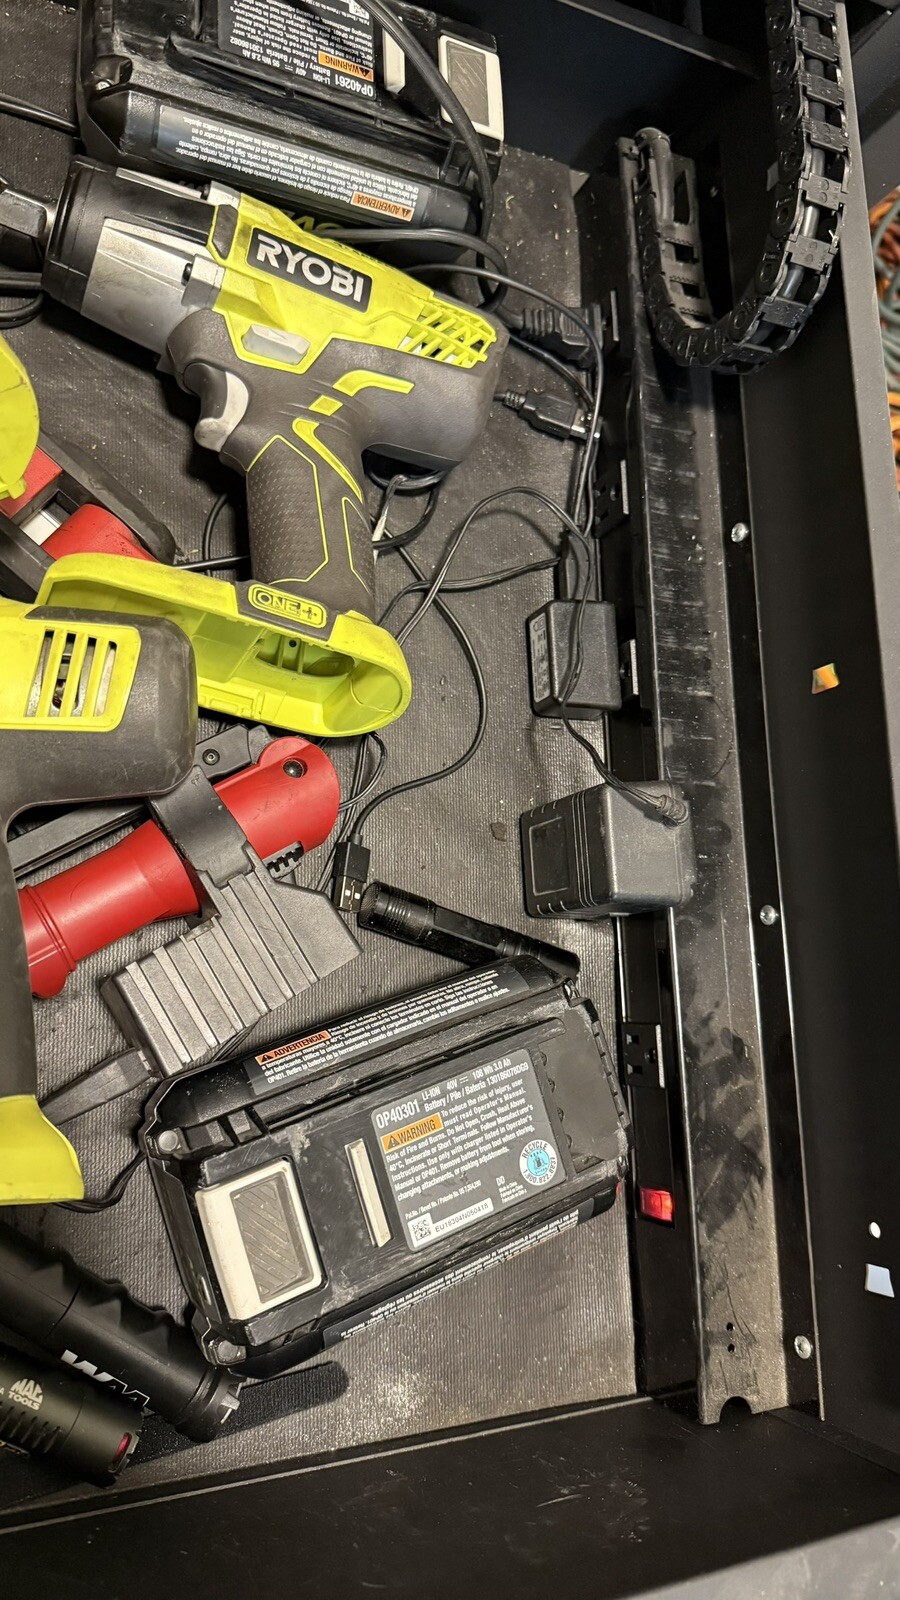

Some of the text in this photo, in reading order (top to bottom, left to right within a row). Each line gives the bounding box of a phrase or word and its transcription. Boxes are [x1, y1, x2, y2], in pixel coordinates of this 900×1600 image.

[325, 55, 358, 73] WARNING
[335, 75, 372, 96] OP40261
[357, 195, 399, 213] ADVERTENCIA
[256, 234, 364, 303] RYOBI
[257, 592, 318, 620] ONE+
[274, 1034, 324, 1056] ADVERTENCIA
[421, 1058, 511, 1100] LI-ION 40V 108 Wh 3.0 Ah
[443, 1087, 525, 1126] must read Operator's Manual.
[448, 1102, 467, 1114] reduce
[477, 1093, 488, 1102] risk
[488, 1089, 494, 1097] of
[494, 1084, 511, 1094] injury,
[511, 1078, 522, 1087] user
[376, 1100, 419, 1127] OP40301
[385, 1152, 399, 1162] Risk
[399, 1148, 406, 1156] of
[406, 1144, 417, 1153] Fire
[418, 1138, 428, 1148] and
[428, 1132, 446, 1143] Burns.
[454, 1123, 464, 1132] Not
[464, 1118, 480, 1127] Open,
[480, 1110, 497, 1121] Crush,
[496, 1103, 509, 1113] Heat
[510, 1098, 525, 1108] Above
[398, 1119, 435, 1142] WARNING
[391, 1163, 426, 1181] Instructions.
[426, 1156, 437, 1165] Use
[438, 1151, 450, 1160] only
[450, 1145, 463, 1155] with
[463, 1136, 483, 1149] charger
[484, 1128, 499, 1139] listed
[505, 1115, 532, 1130] Operator's
[394, 1176, 414, 1191] Manual
[421, 1166, 439, 1178] OP401.
[439, 1157, 460, 1170] Remove
[460, 1149, 478, 1161] battery
[478, 1143, 491, 1152] from
[491, 1137, 502, 1147] tool
[501, 1132, 515, 1142] when
[515, 1124, 534, 1136] storing,
[522, 1140, 548, 1158] RECYCLE
[397, 1186, 421, 1200] changing
[421, 1171, 453, 1189] attachments,
[460, 1159, 478, 1172] making
[479, 1146, 508, 1163] adjustments.
[8, 1392, 40, 1411] TOOLS
[10, 1378, 43, 1402] MAC
